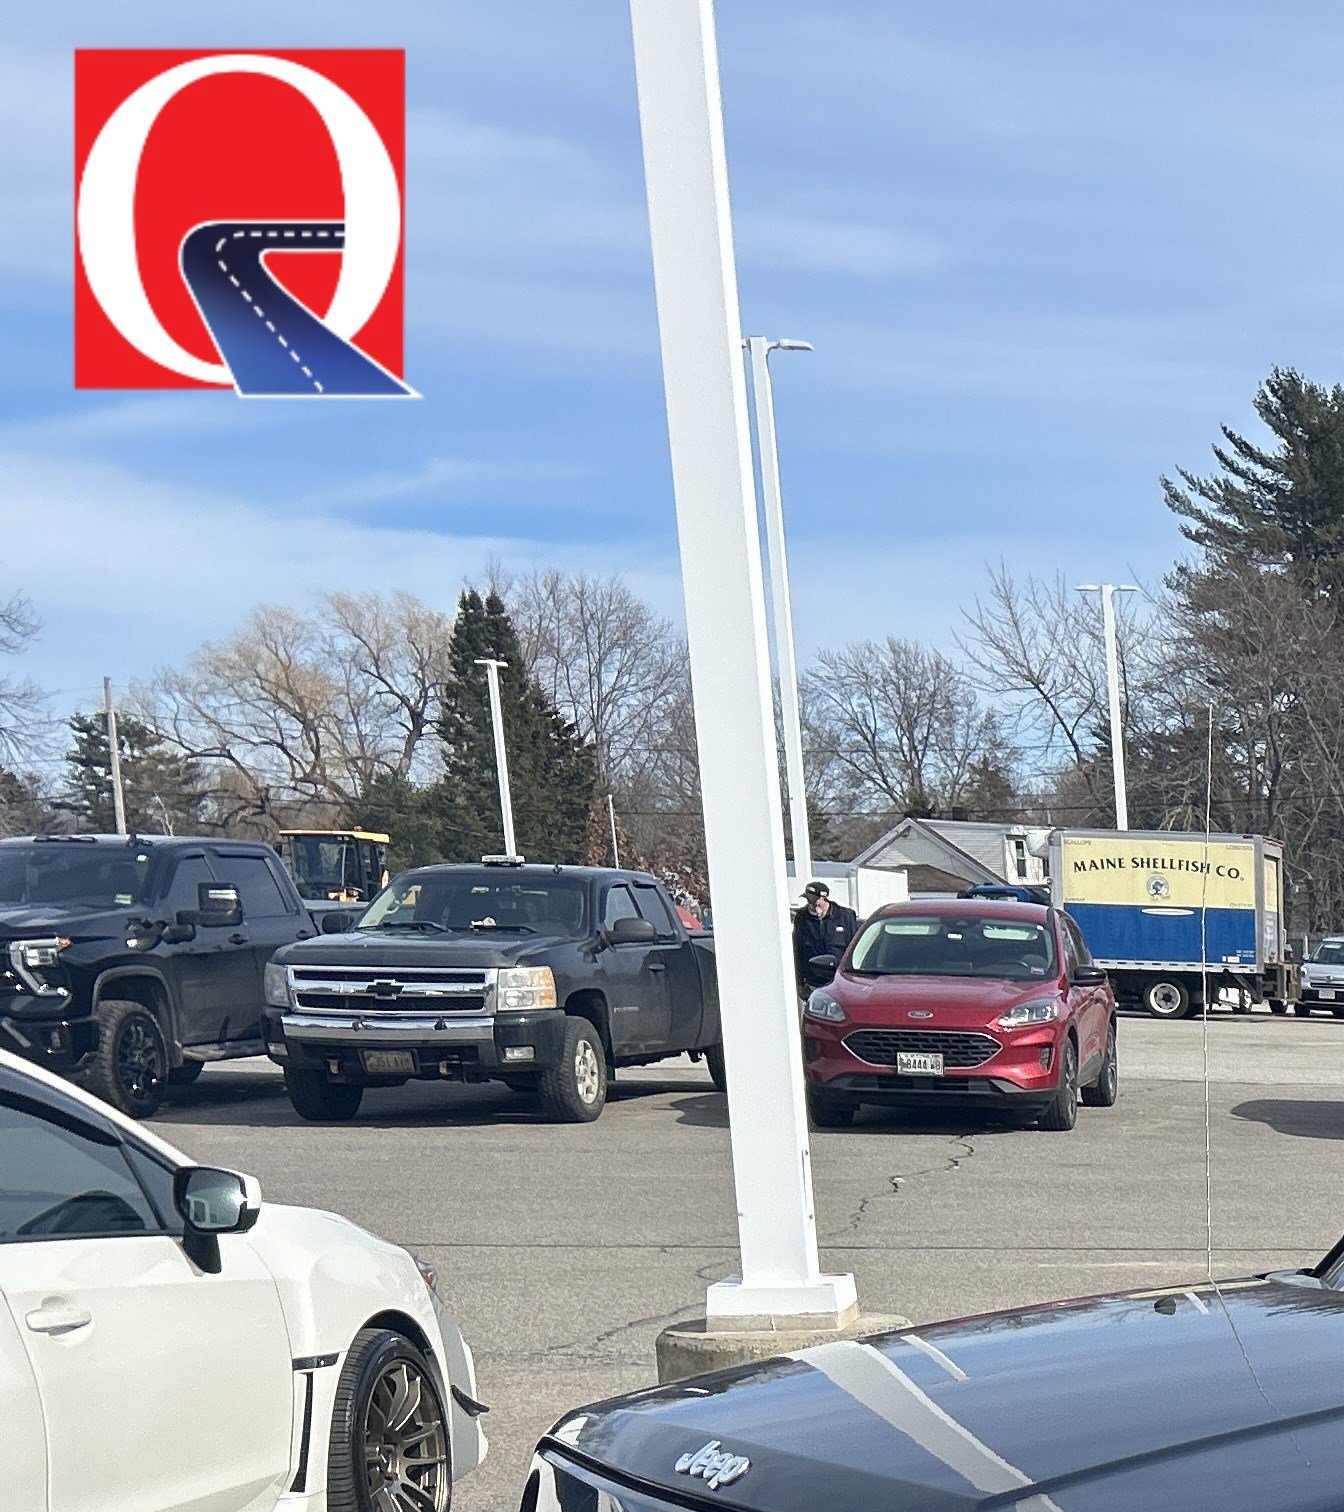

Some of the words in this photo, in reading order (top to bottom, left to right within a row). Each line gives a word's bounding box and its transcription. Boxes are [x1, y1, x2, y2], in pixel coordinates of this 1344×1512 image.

[1073, 857, 1125, 873] MAINE
[1131, 856, 1211, 875] SHELLFISH
[1215, 865, 1245, 881] CO.
[674, 1440, 750, 1490] Jeep
